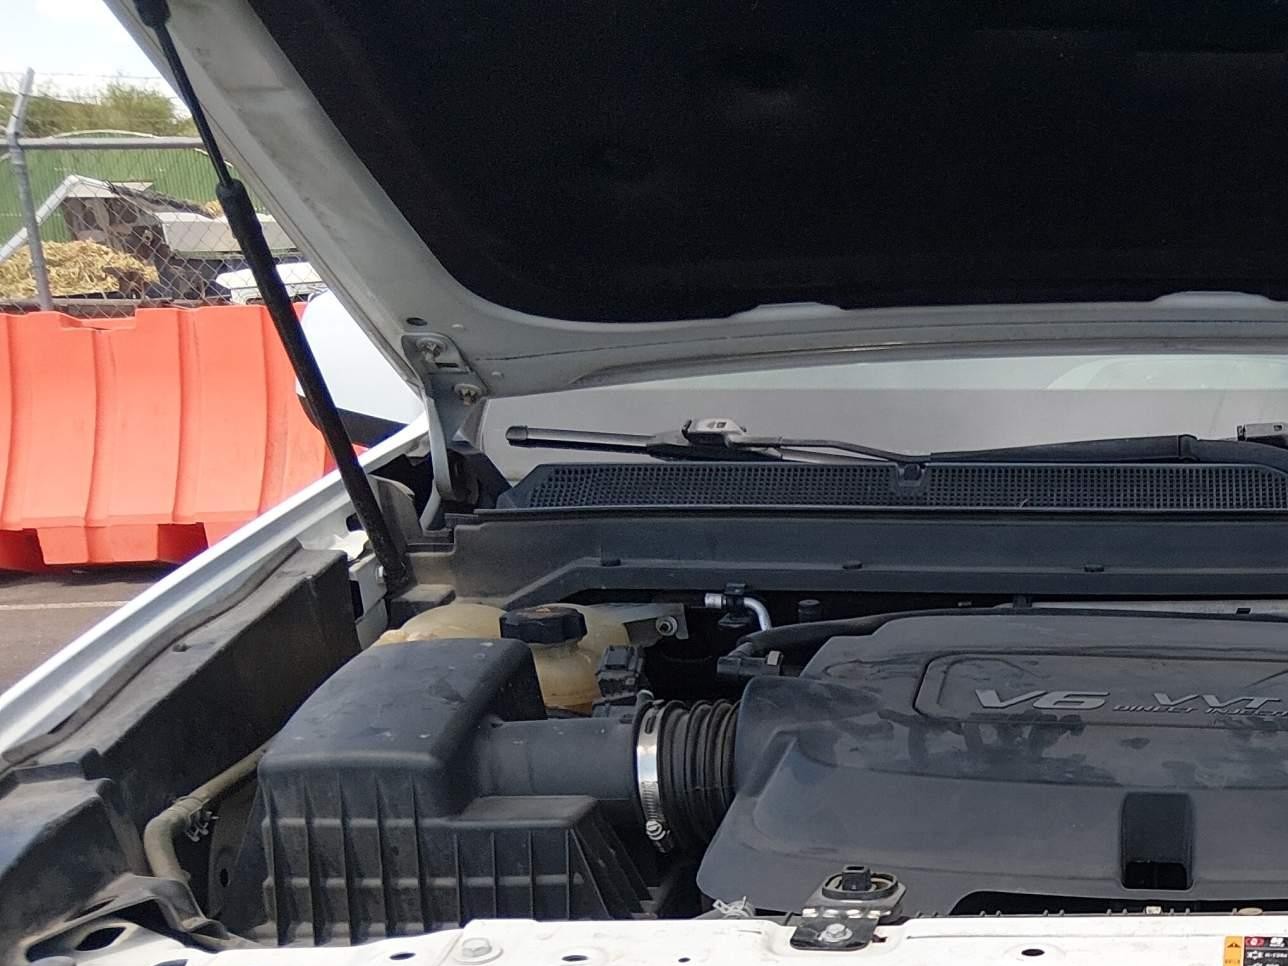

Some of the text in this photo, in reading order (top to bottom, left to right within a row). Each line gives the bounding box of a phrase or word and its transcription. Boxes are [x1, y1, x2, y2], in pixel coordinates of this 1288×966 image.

[975, 689, 1282, 710] V6 VVT
[1111, 704, 1195, 713] DIRECT
